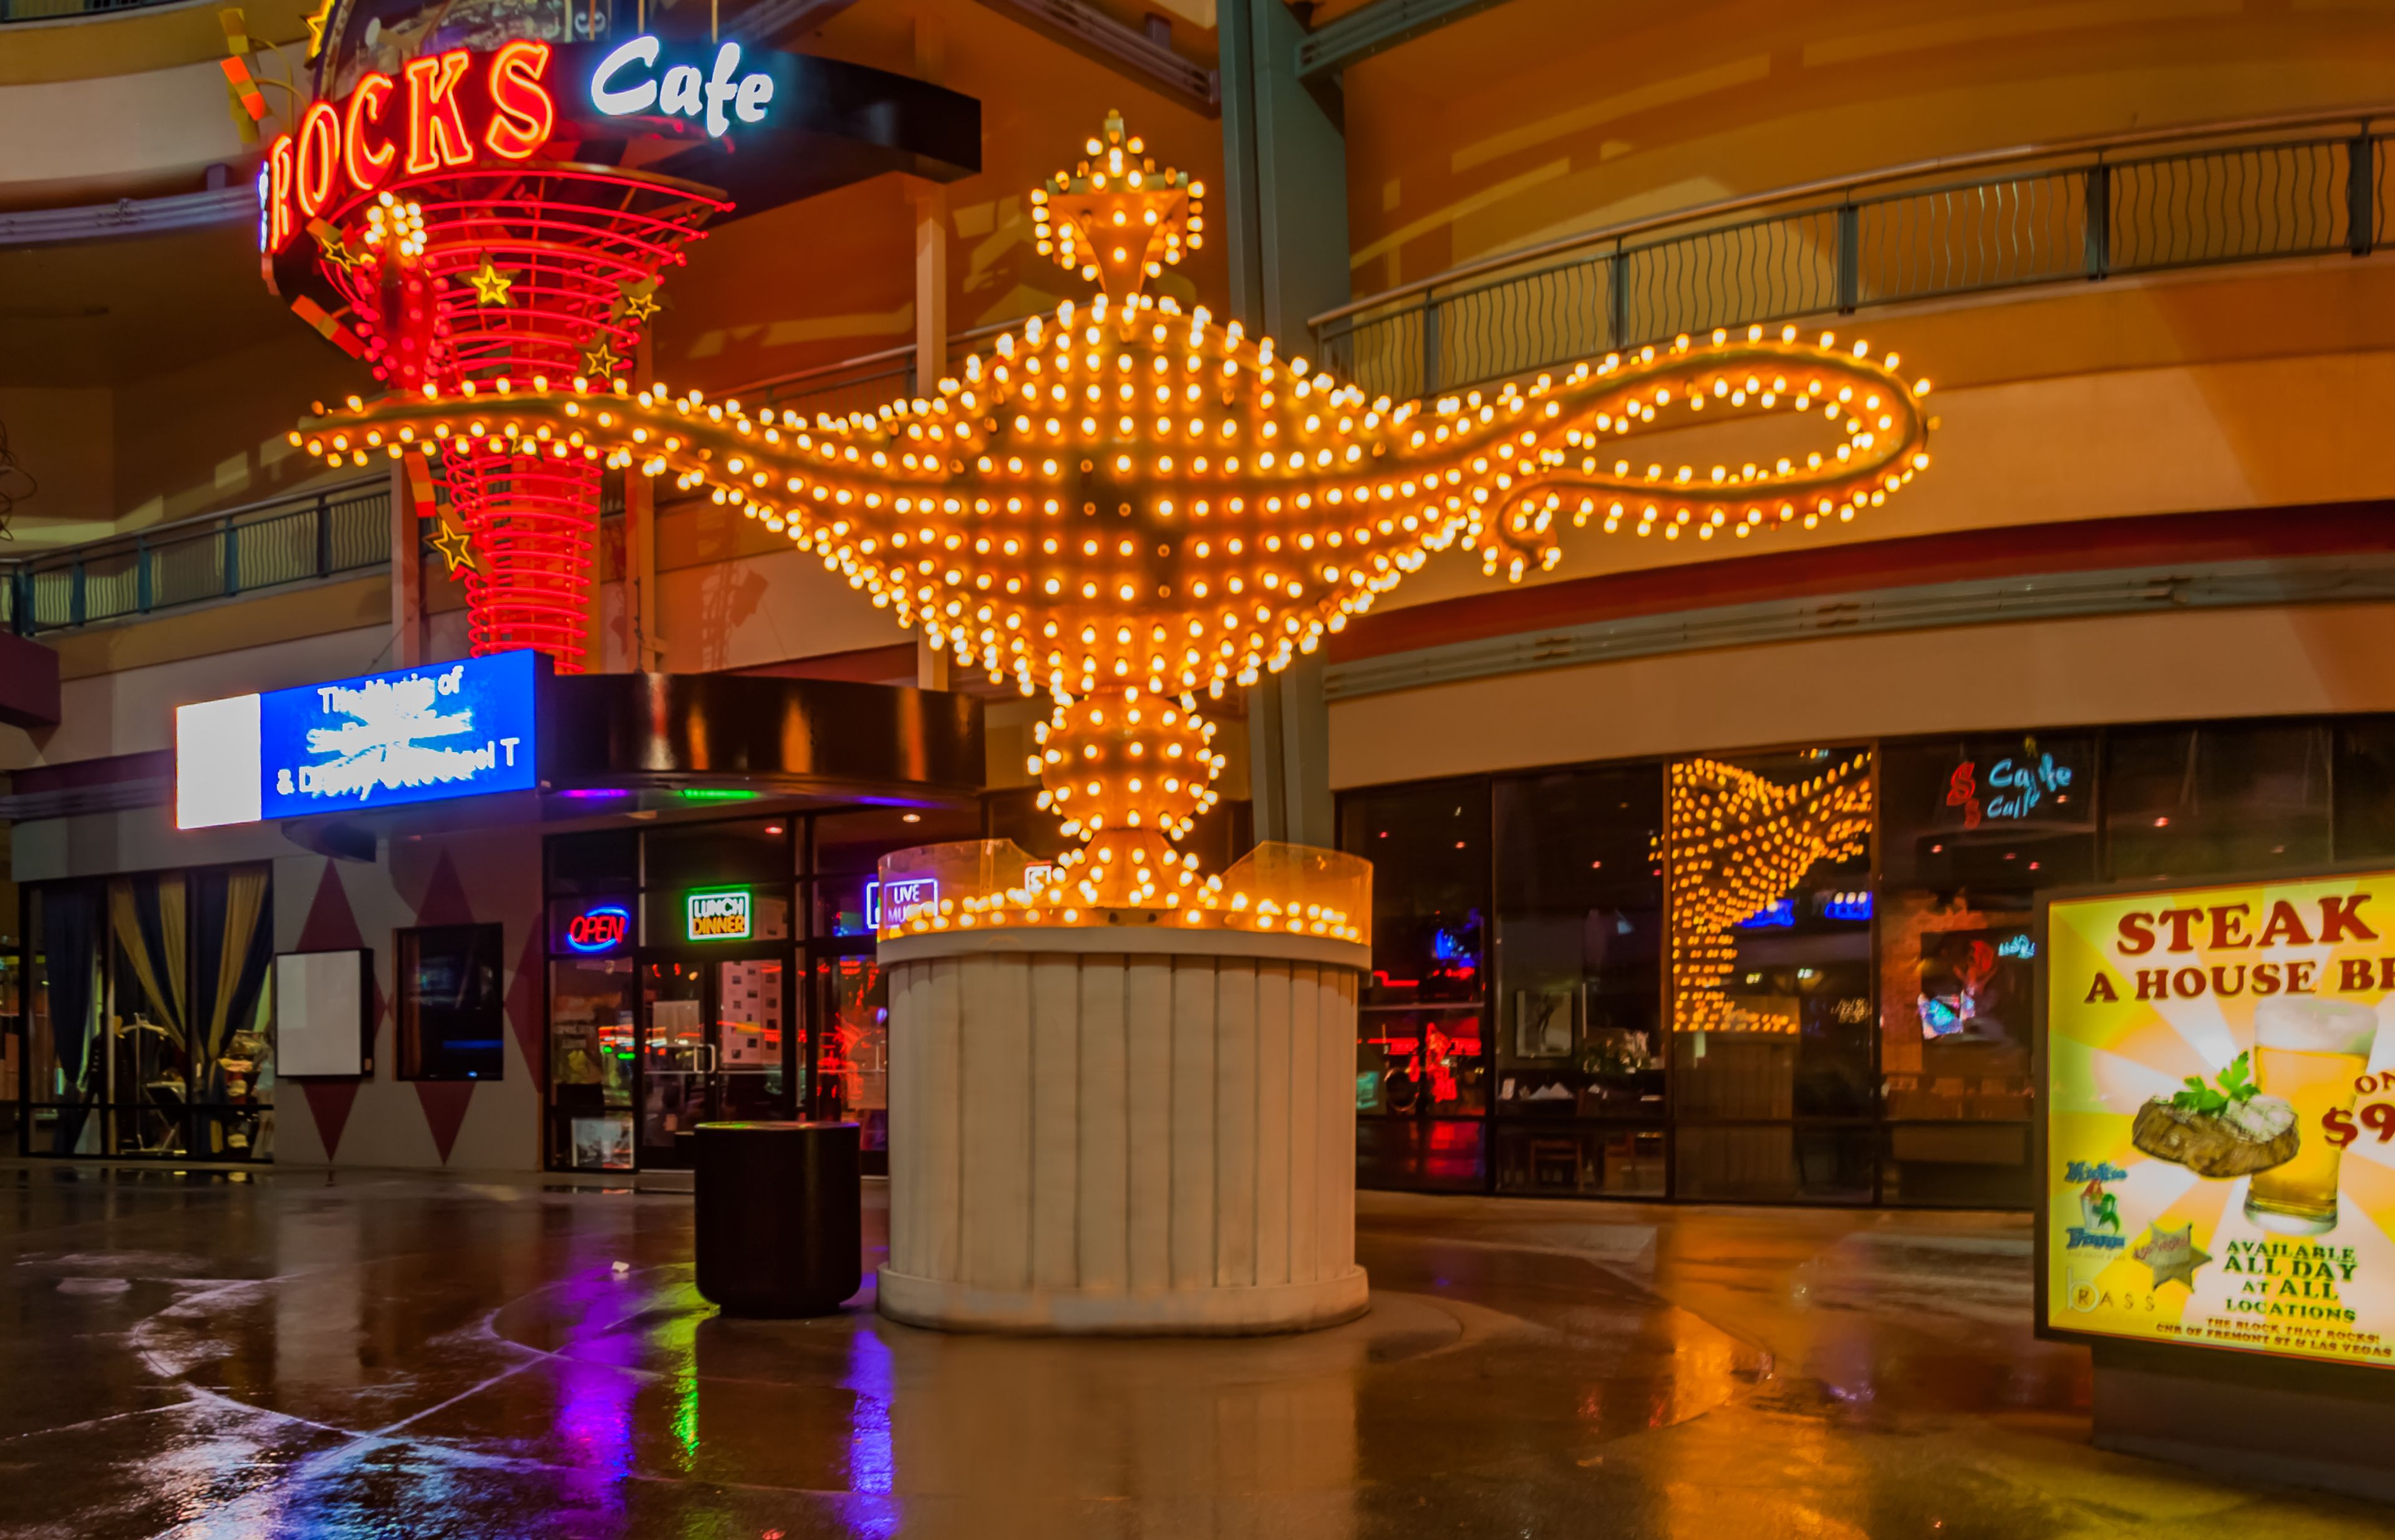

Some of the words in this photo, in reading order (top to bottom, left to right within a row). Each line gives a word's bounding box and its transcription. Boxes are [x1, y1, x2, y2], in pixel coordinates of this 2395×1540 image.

[591, 36, 774, 137] Cafe
[269, 39, 554, 254] ROCKS
[438, 666, 464, 695] of
[694, 898, 743, 918] LUNCH
[894, 884, 920, 904] LIVE
[569, 915, 626, 944] OPEN
[693, 915, 745, 935] DINNER
[2117, 893, 2379, 956] STEAK
[2084, 971, 2119, 1004] A
[2135, 961, 2316, 1001] HOUSE
[2227, 1241, 2356, 1262] AVAILABLE
[2223, 1254, 2281, 1276] ALL
[2292, 1260, 2357, 1282] DAY
[2243, 1281, 2269, 1294] AT
[2278, 1279, 2338, 1300] ALL
[2226, 1299, 2356, 1323] LOCATIONS
[2156, 1323, 2182, 1334] CNR
[2186, 1326, 2203, 1336] OF
[2207, 1329, 2270, 1344] FREMONT
[2274, 1336, 2291, 1347] ST
[2310, 1340, 2337, 1352] LAS
[2341, 1343, 2392, 1358] VEGAS
[2207, 1318, 2231, 1329] THE
[2236, 1320, 2280, 1334] BLOCK
[2285, 1326, 2321, 1339] THAT
